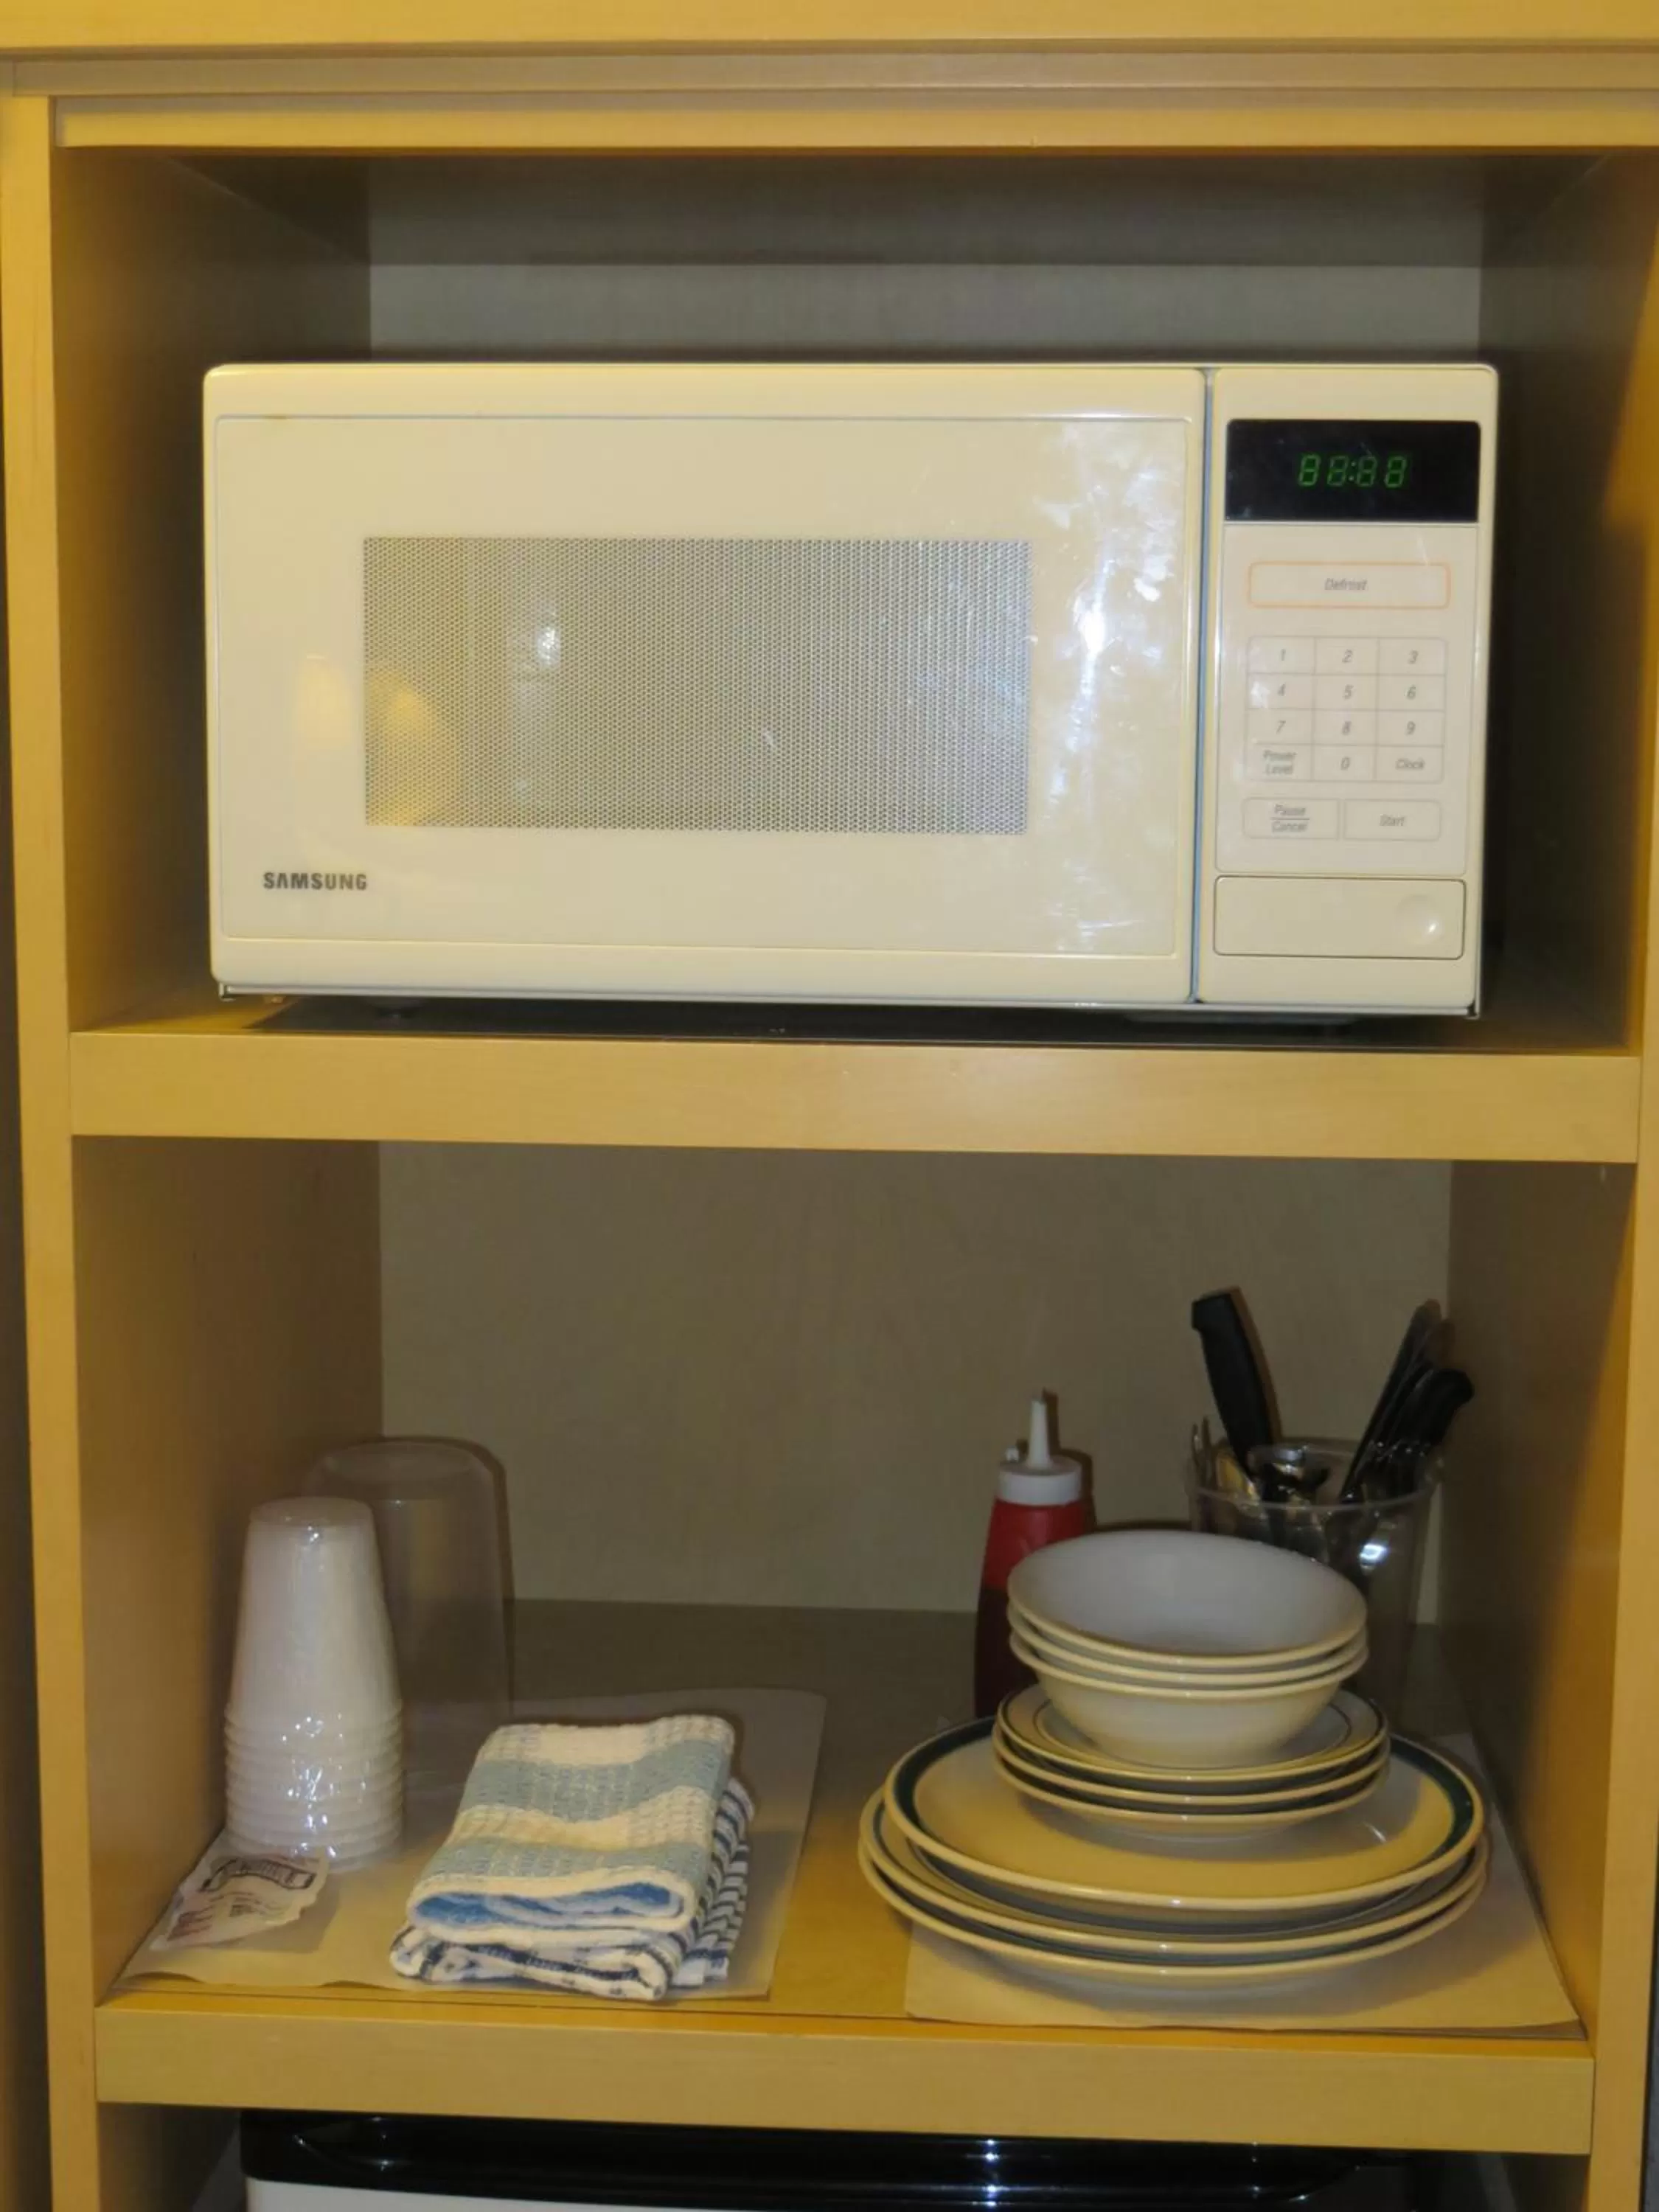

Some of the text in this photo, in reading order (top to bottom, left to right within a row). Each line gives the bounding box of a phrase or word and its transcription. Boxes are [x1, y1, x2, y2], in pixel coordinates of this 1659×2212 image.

[1280, 649, 1286, 661] 1
[1342, 649, 1353, 663] 2
[1408, 650, 1419, 664] 3
[1277, 684, 1286, 697] 4
[1343, 684, 1353, 699] 5
[1406, 685, 1416, 699] 6
[1276, 720, 1286, 734] 7
[1342, 721, 1352, 735] 8
[1406, 721, 1416, 735] 9
[1340, 757, 1350, 771] 0
[263, 872, 367, 890] SAMSUNG
